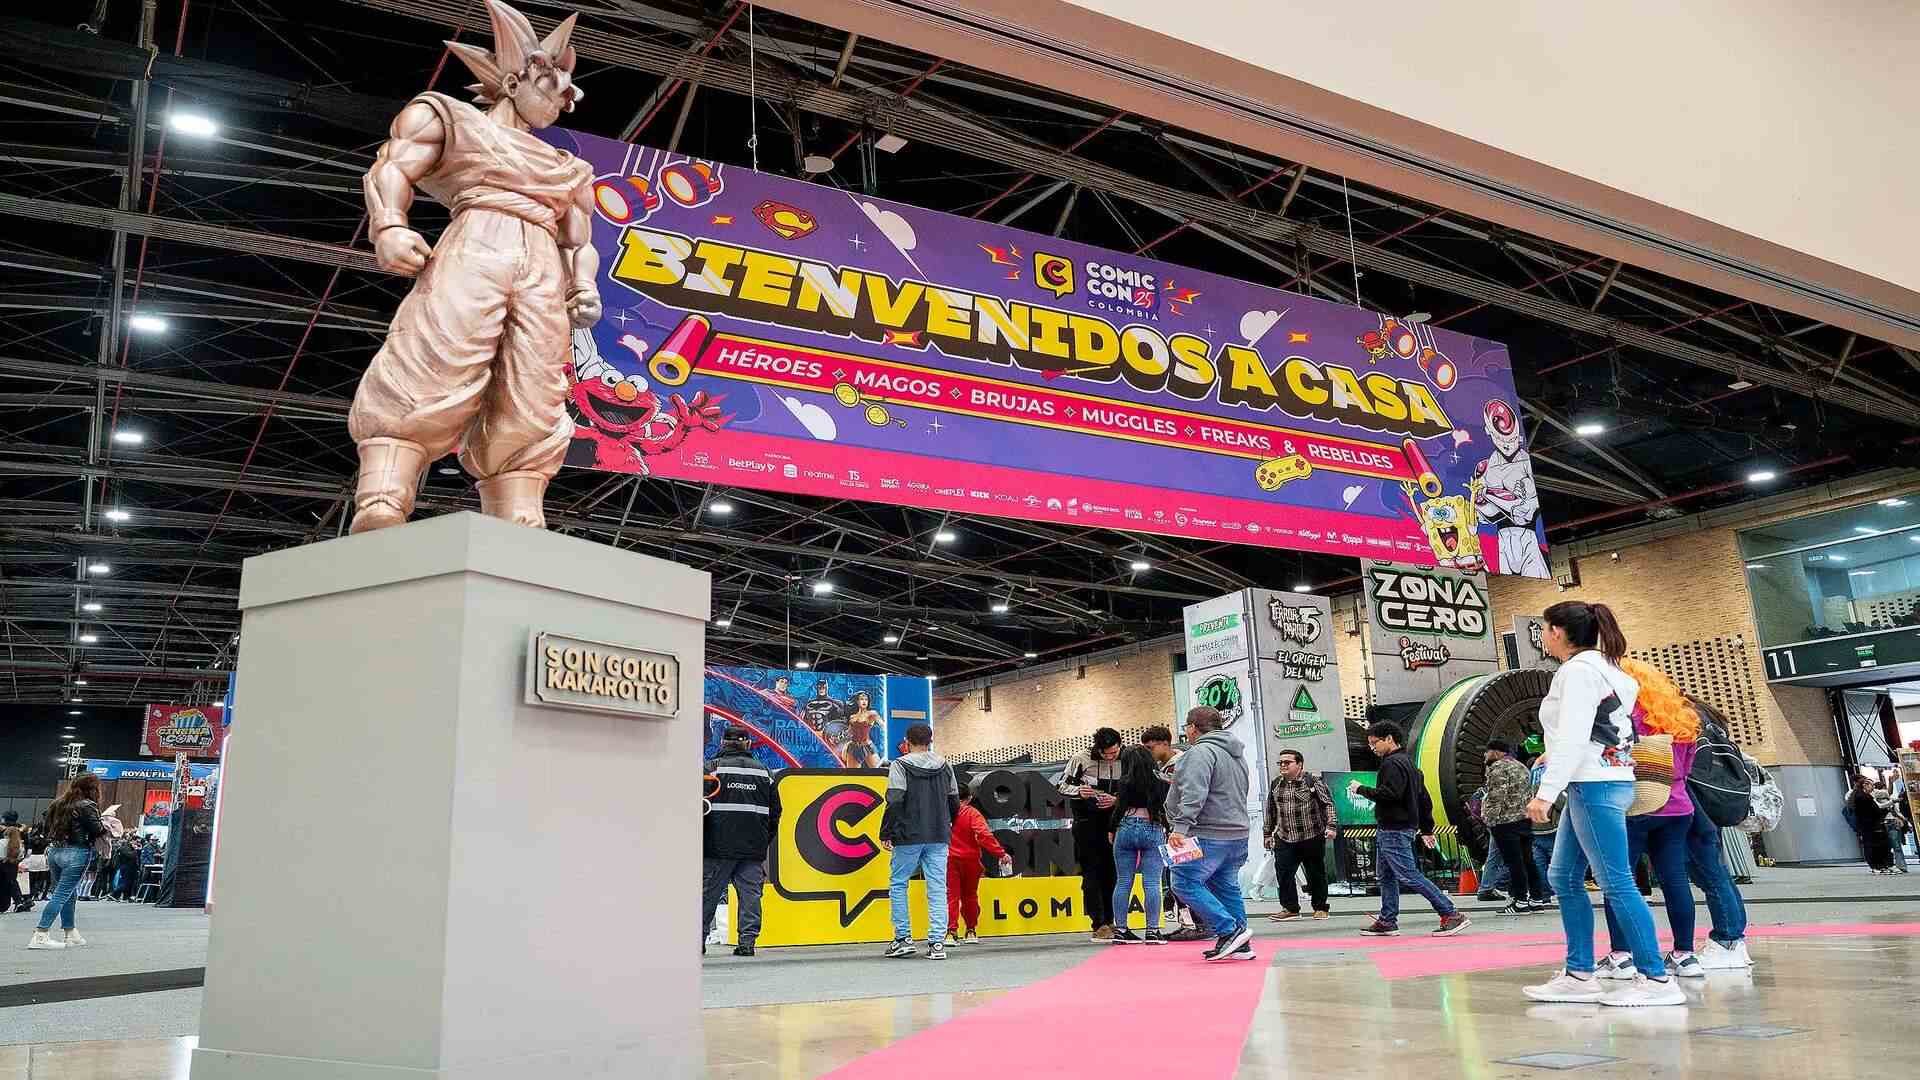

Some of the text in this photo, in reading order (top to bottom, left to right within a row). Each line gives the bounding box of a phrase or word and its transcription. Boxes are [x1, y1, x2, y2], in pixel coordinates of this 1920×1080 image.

[1086, 262, 1155, 290] COMIC
[1087, 280, 1155, 309] CON 25
[1088, 300, 1159, 321] COLOMBIA
[613, 227, 1453, 431] BIENVENIDOS A CASA
[716, 347, 1394, 470] HÉROES MAGOS BRUJAS MUGGLES FREAKS & REBELDES
[1299, 607, 1322, 643] 5
[545, 646, 671, 684] SON GOKU
[1278, 650, 1328, 668] EL ORIGEN
[1401, 642, 1449, 669] Festival
[1768, 649, 1798, 678] 11
[546, 667, 672, 704] KAKAROTTO
[1284, 665, 1324, 680] DEL MAL
[121, 770, 151, 778] ROYAL
